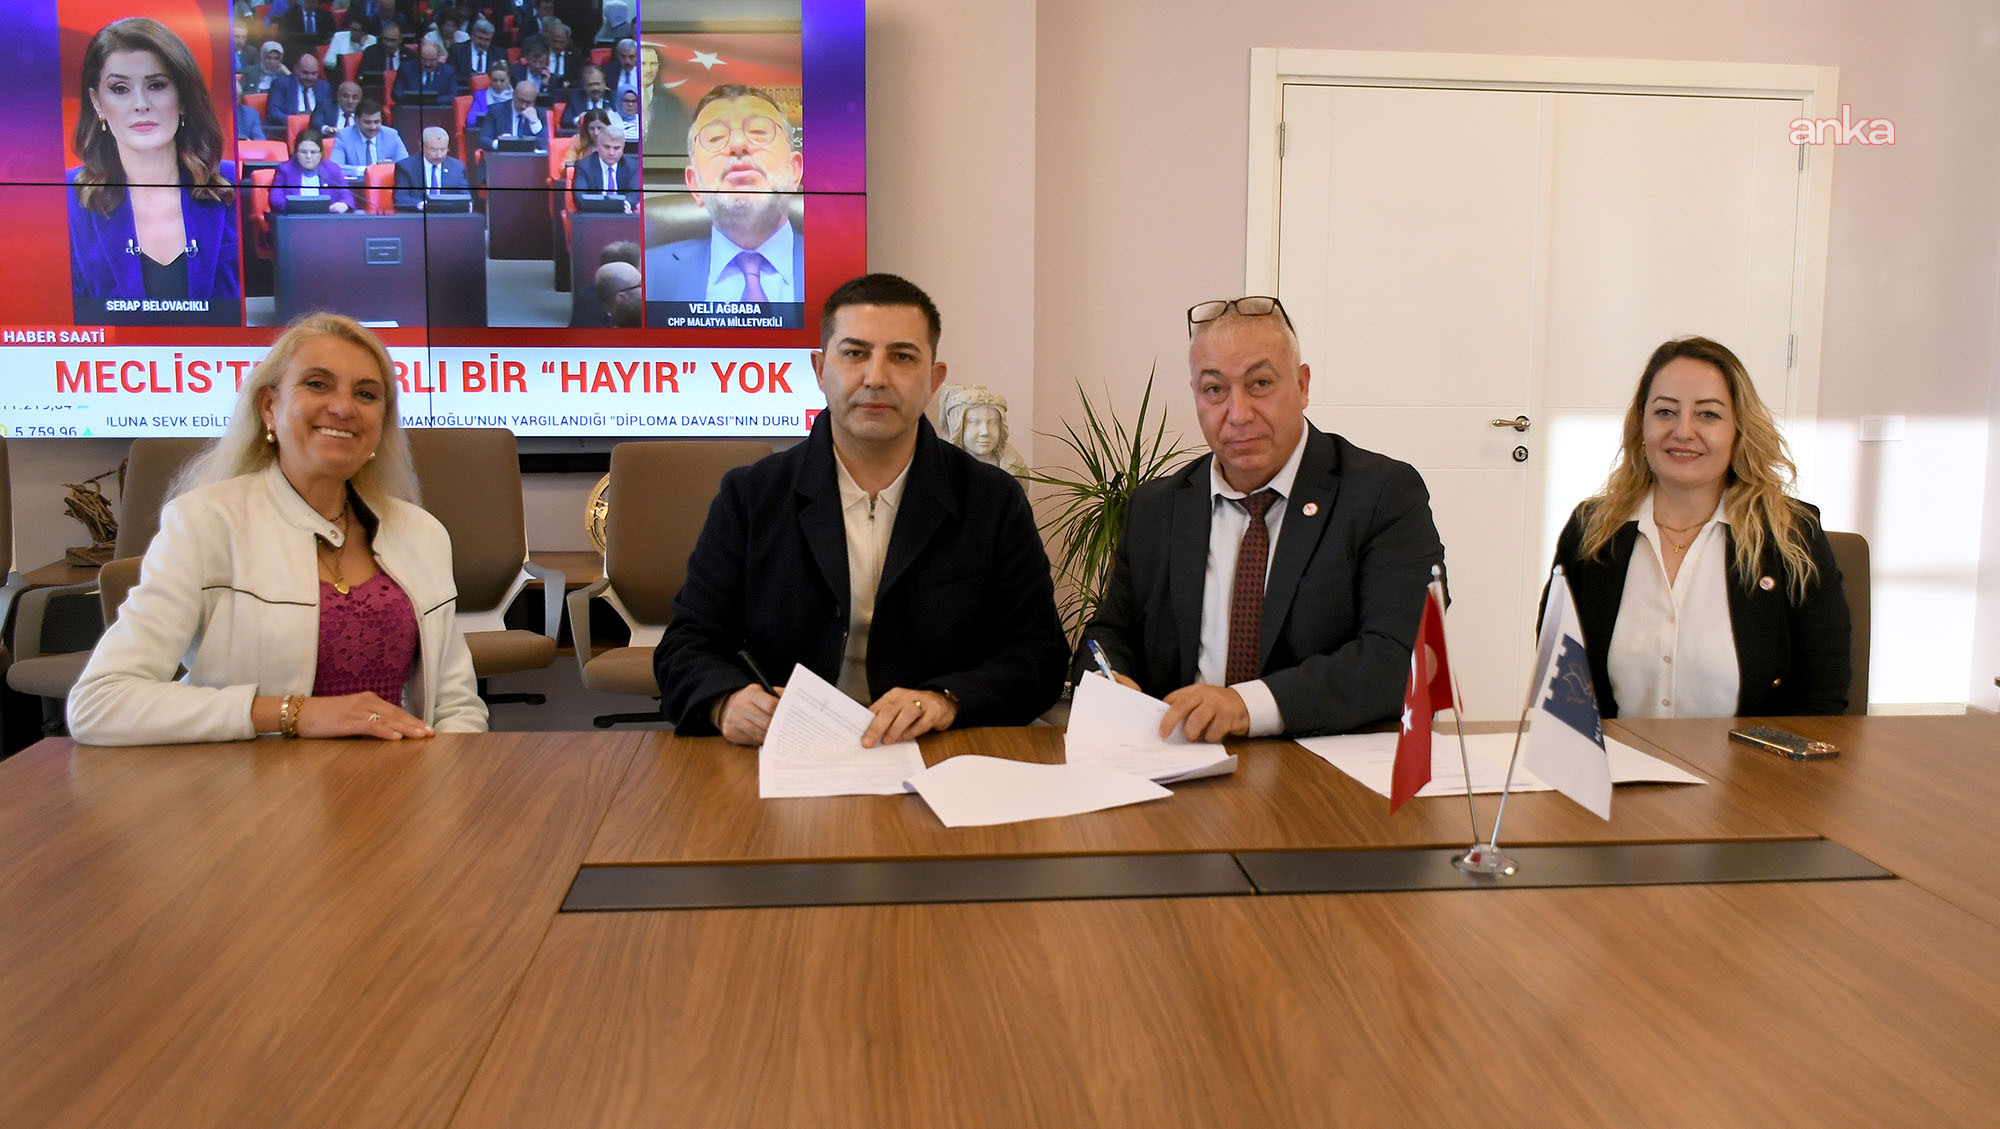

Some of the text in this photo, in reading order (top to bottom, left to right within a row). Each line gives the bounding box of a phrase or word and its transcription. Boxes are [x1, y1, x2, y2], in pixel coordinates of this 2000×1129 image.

[106, 300, 209, 311] SERAP BELOVACIKLI
[688, 300, 761, 314] VELİ AĞBABA
[667, 316, 783, 327] CHP MALATYA MİLLETVEKİLİ
[3, 328, 105, 343] HABER SAATİ
[55, 353, 263, 393] MECLİS'T
[462, 353, 528, 393] BİR
[711, 360, 793, 393] YOK
[152, 416, 188, 427] SEVK
[192, 413, 232, 427] EDİLD
[402, 412, 507, 426] MAMOĞLU'NUN
[511, 412, 606, 426] YARGILANDIĞI
[762, 415, 799, 426] DURU
